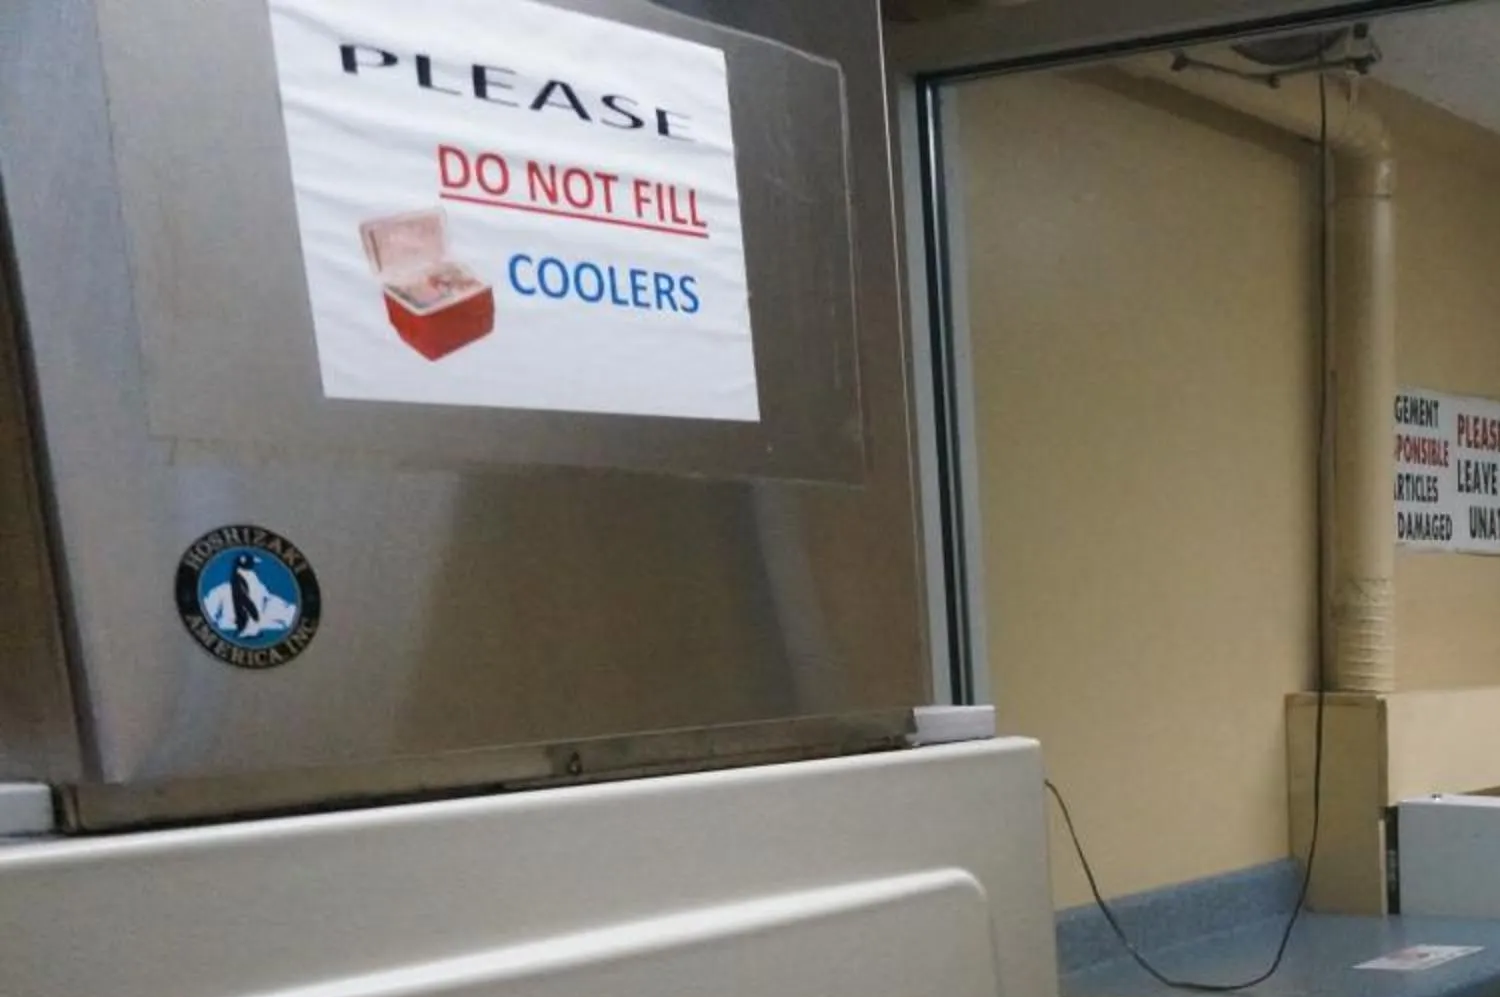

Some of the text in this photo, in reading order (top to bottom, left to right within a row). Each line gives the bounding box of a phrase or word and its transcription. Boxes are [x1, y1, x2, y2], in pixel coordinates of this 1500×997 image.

[339, 44, 696, 142] PLEASE
[438, 144, 708, 229] DO NOT FILL
[508, 253, 701, 314] COOLERS
[1457, 459, 1499, 496] LEAVE
[185, 527, 308, 575] HOSHIZAKI
[1397, 511, 1453, 541] DAMAGED
